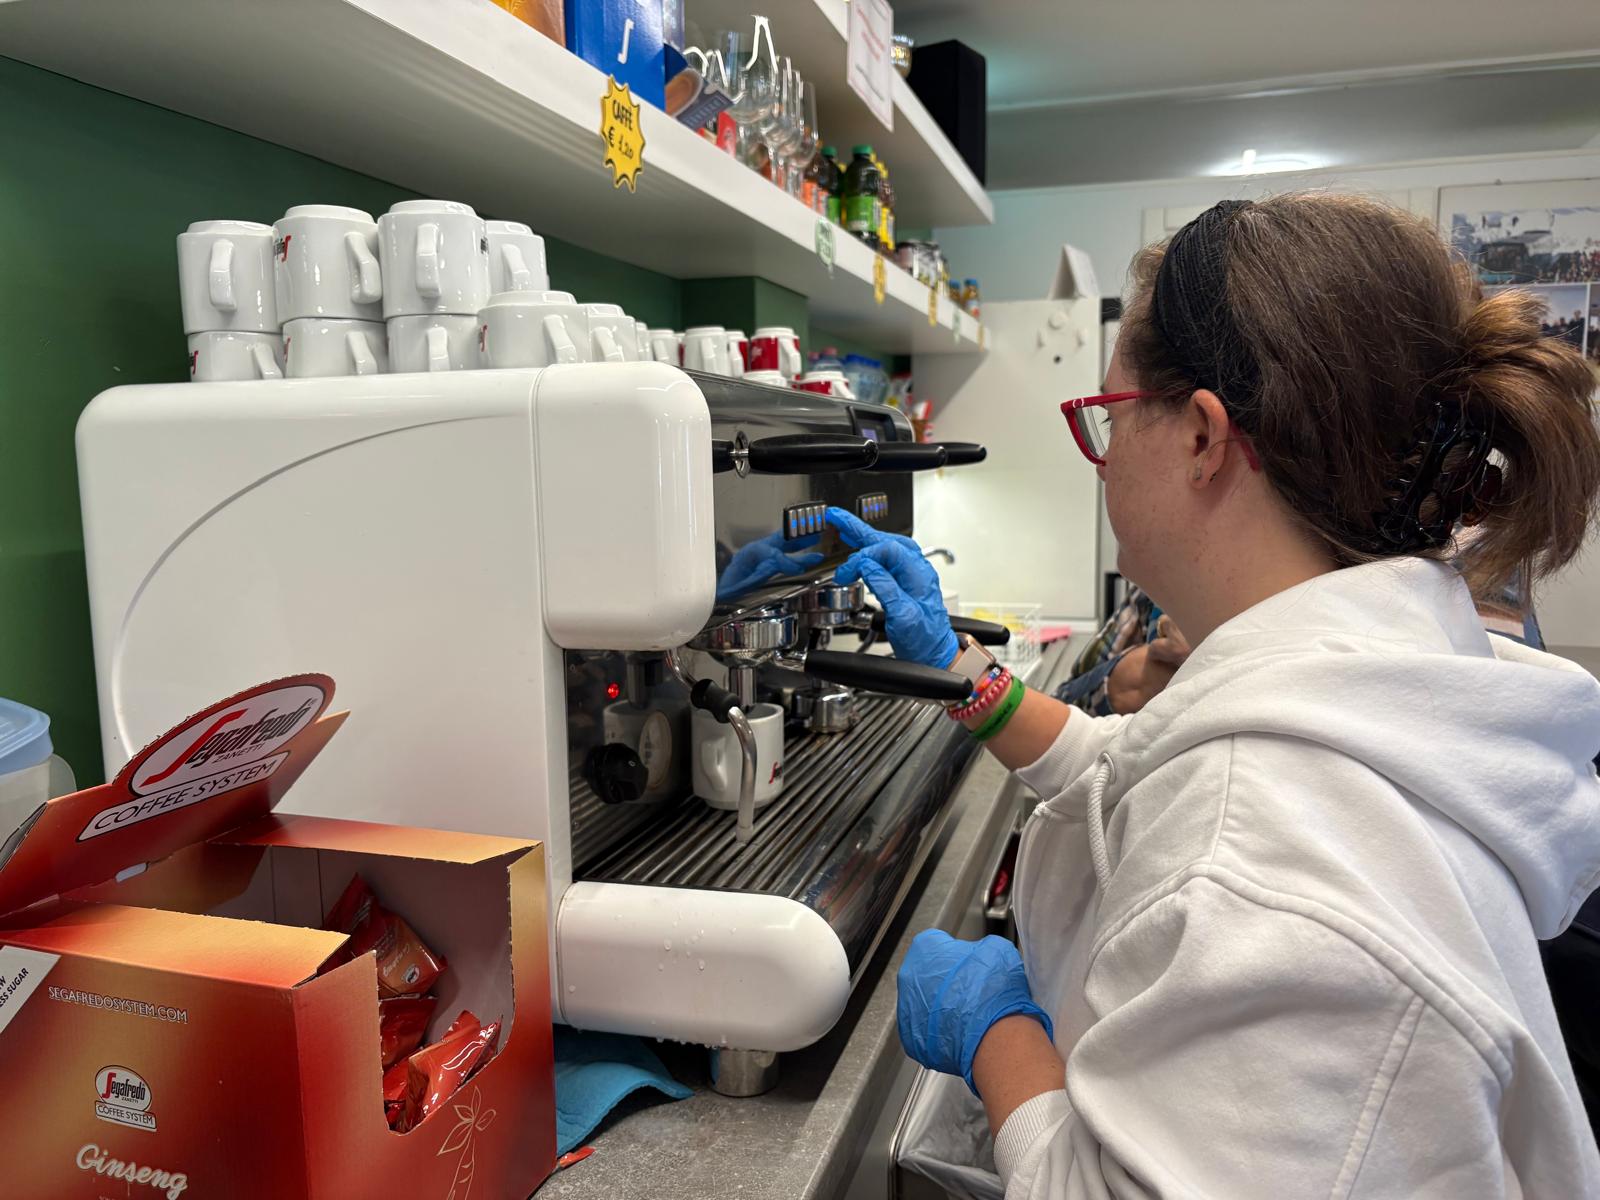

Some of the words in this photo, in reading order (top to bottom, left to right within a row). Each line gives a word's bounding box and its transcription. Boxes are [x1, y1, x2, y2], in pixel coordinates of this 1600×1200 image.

[139, 697, 313, 788] Segafredo
[211, 741, 267, 764] ZANETTI
[94, 786, 191, 830] COFFEE
[192, 759, 277, 798] SYSTEM
[7, 967, 29, 995] SUGAR
[48, 986, 188, 1024] SEGAFREDOSYSTEM.COM
[102, 1071, 146, 1101] Segafredo
[97, 1104, 125, 1119] COFFEE
[125, 1110, 154, 1126] SYSTEM
[76, 1143, 188, 1200] Ginseng
